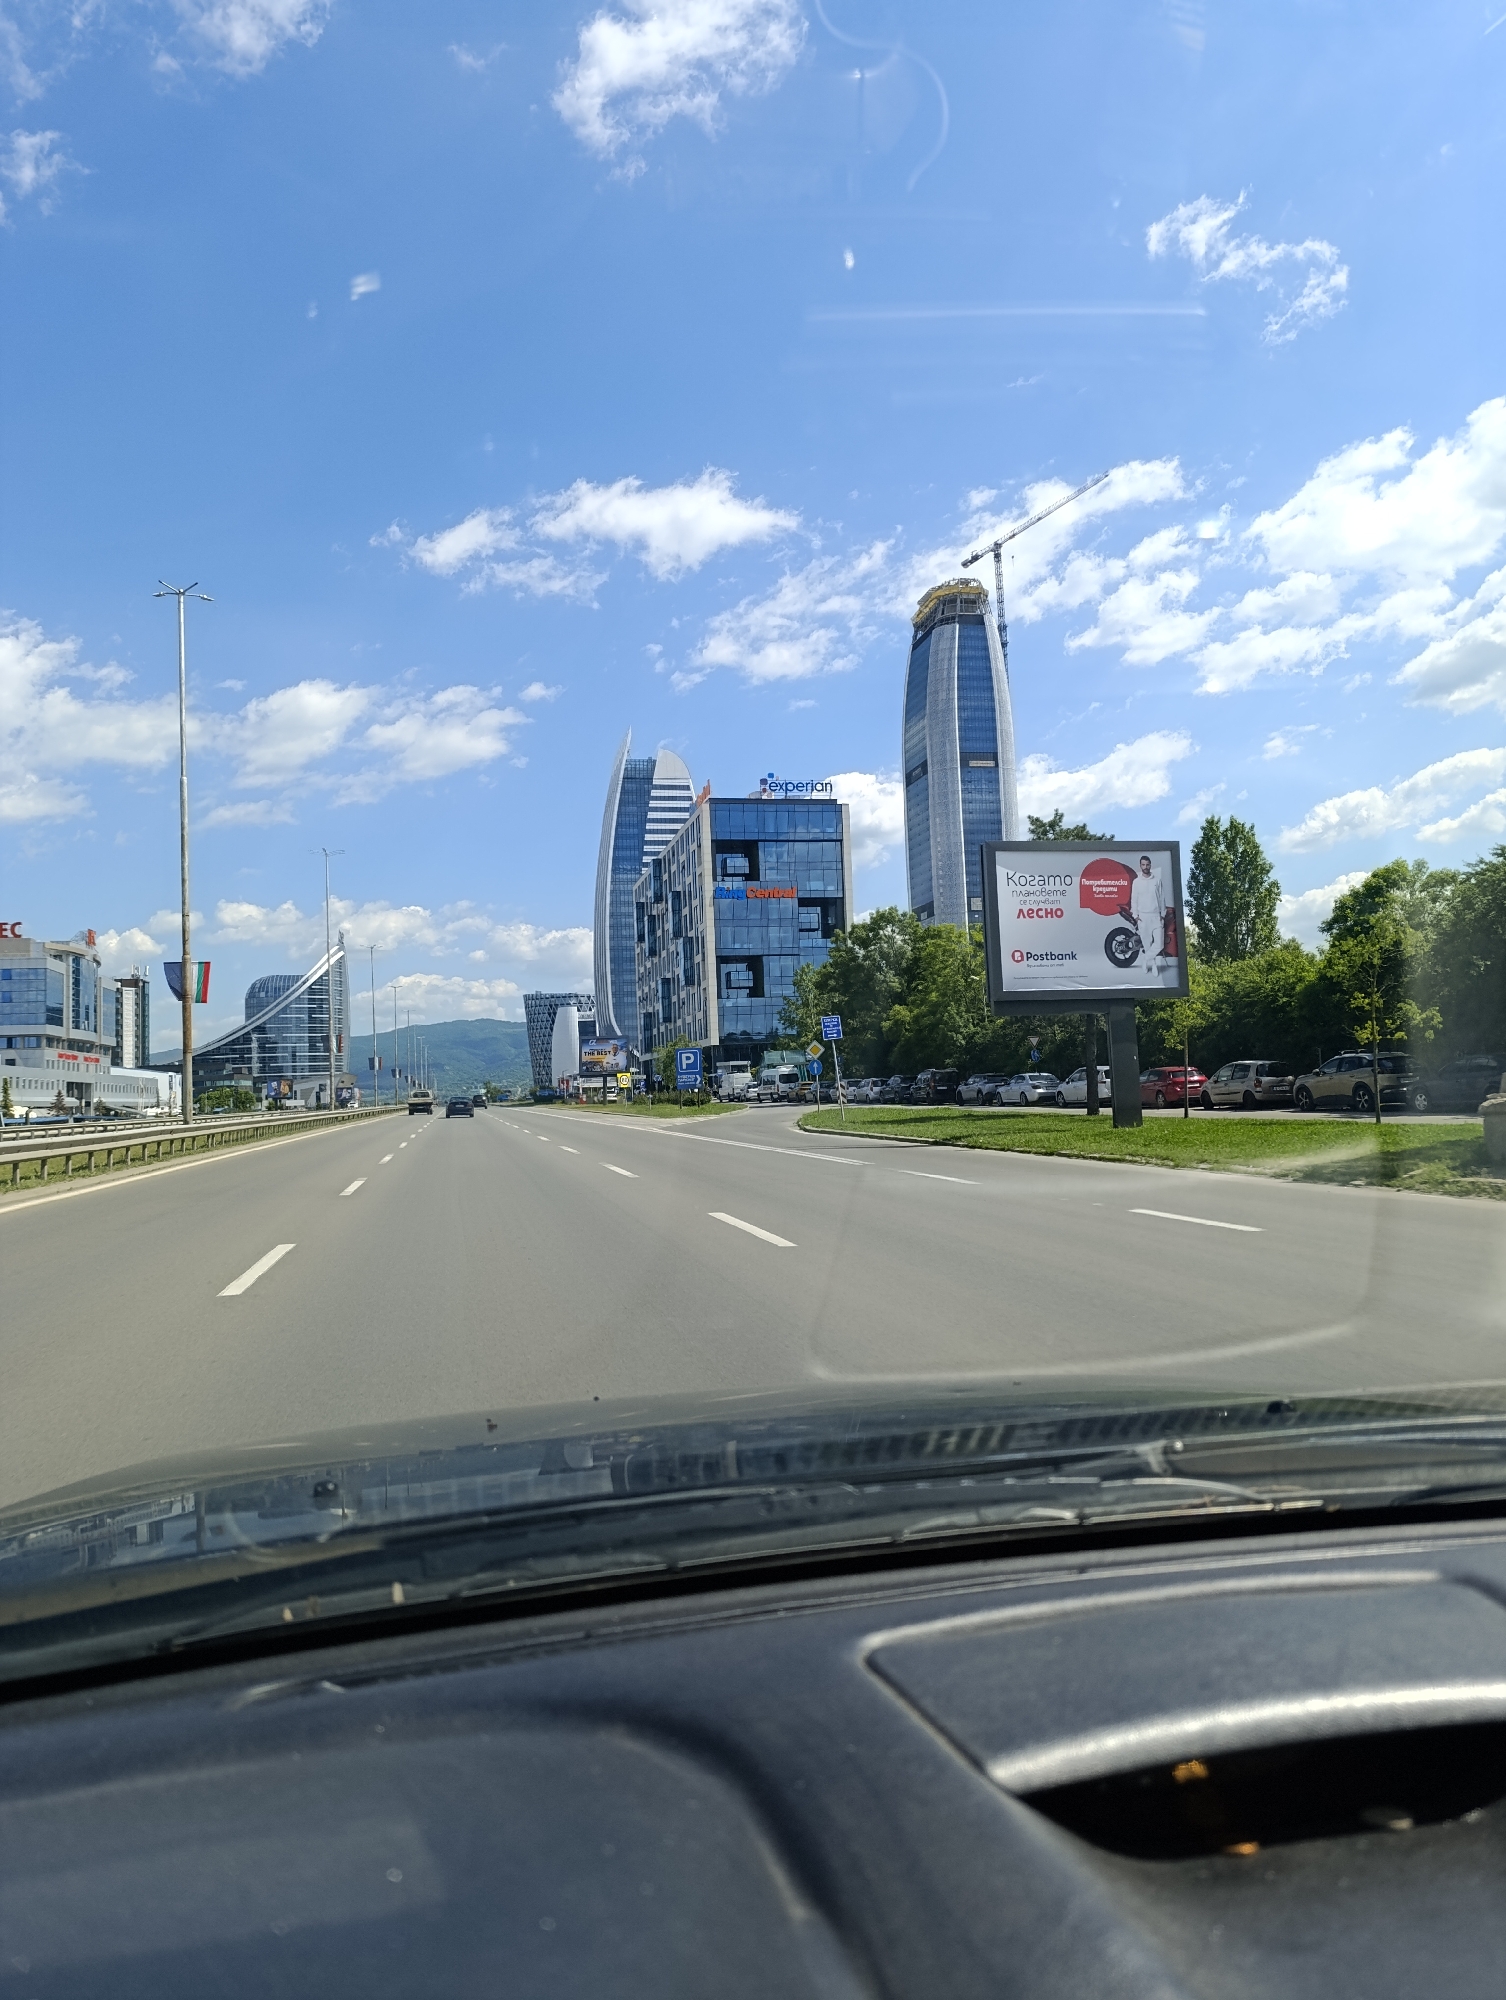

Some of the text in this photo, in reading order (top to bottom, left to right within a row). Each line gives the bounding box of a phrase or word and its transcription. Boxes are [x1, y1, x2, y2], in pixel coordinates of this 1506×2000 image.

[768, 780, 833, 794] experian
[1006, 871, 1073, 887] Когато
[1011, 887, 1067, 898] плановете
[1028, 898, 1061, 906] случват
[1026, 951, 1078, 961] Postbank
[681, 1053, 695, 1070] P
